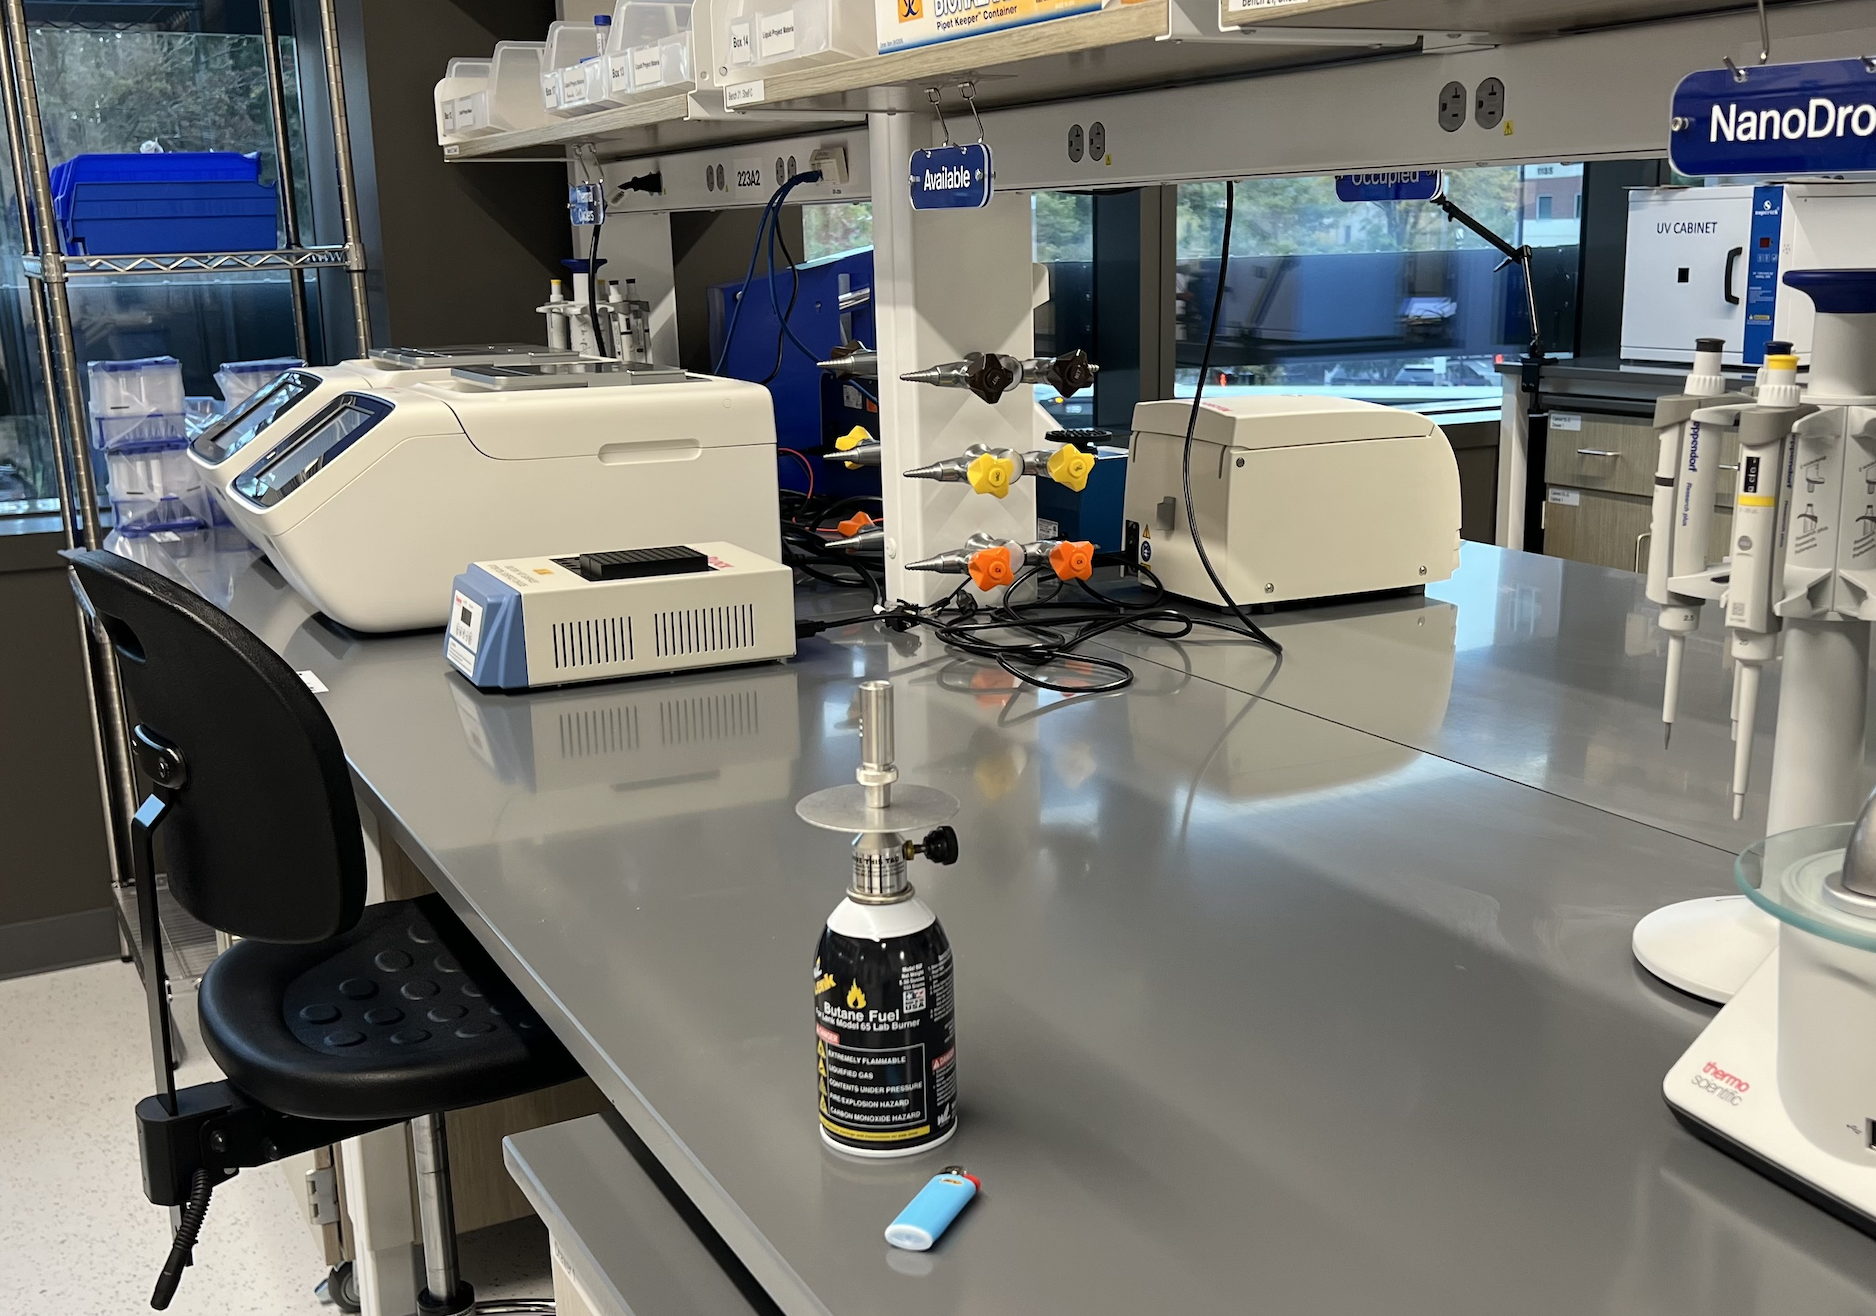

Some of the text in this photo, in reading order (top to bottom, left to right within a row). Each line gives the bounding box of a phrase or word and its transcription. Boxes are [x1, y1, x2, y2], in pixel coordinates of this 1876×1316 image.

[937, 20, 953, 31] Pipet
[984, 5, 1018, 20] Container
[733, 35, 749, 48] Box 14
[763, 31, 772, 39] Liquid
[772, 28, 783, 37] Project
[612, 68, 620, 78] Box
[737, 170, 761, 187] 223A2
[924, 165, 971, 192] Available
[1352, 171, 1420, 188] Occupied
[1657, 222, 1718, 234] UV CABINET
[1689, 421, 1700, 473] eppendorf
[824, 1001, 900, 1023] Butane Fuel
[822, 1013, 836, 1025] Lenk
[836, 1018, 859, 1031] Model
[860, 1022, 871, 1032] 65
[873, 1022, 890, 1032] Lab
[892, 1019, 921, 1031] Burner
[828, 1049, 907, 1065] EXTREMELY FLAMMABLE
[858, 1071, 874, 1081] GAS
[1703, 1061, 1750, 1093] thermo
[829, 1078, 923, 1094] CONTENTS UNDER PRESSURE
[1691, 1075, 1743, 1107] scientific
[880, 1099, 910, 1109] HAZARD
[830, 1106, 921, 1123] CARBON MONOXIDE HAZARD
